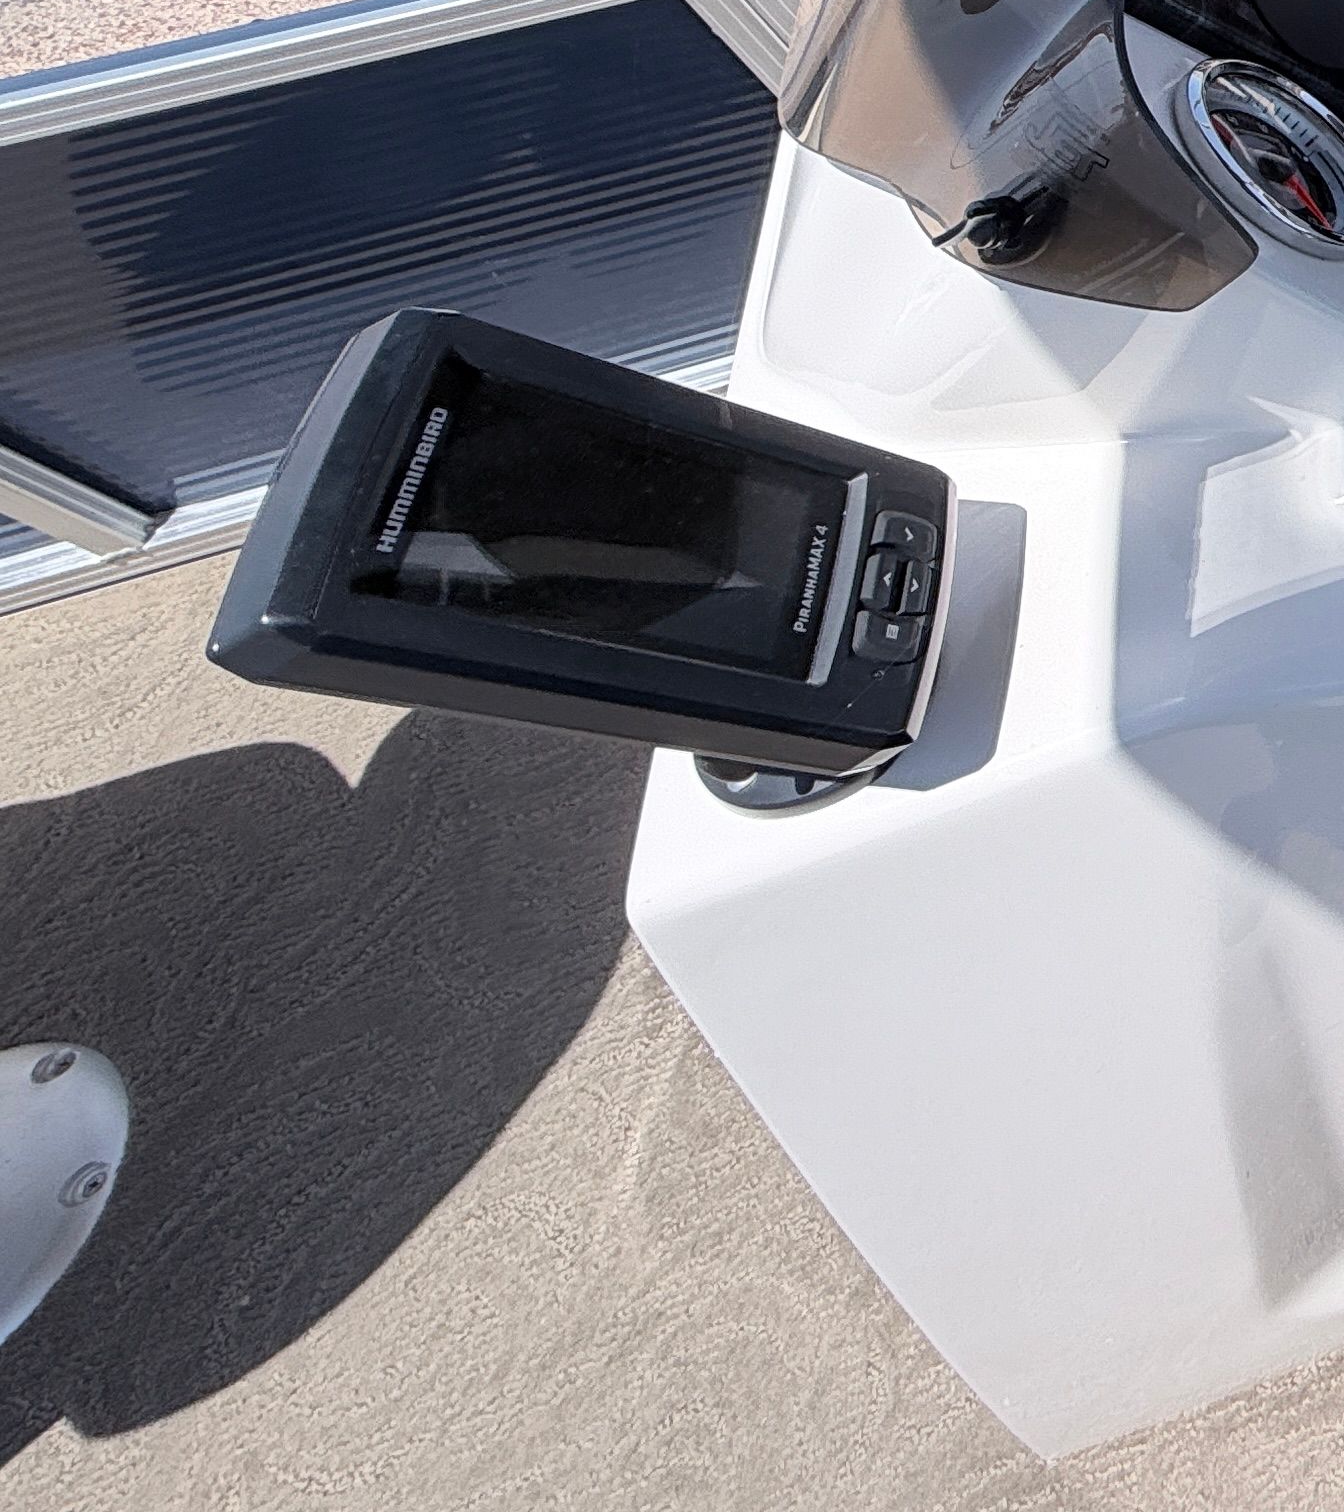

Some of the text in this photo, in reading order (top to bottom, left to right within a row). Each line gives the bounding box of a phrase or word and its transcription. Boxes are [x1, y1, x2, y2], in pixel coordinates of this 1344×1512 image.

[376, 407, 448, 553] HUMMINBIRD
[793, 524, 829, 634] PIRANHAMAX 4
